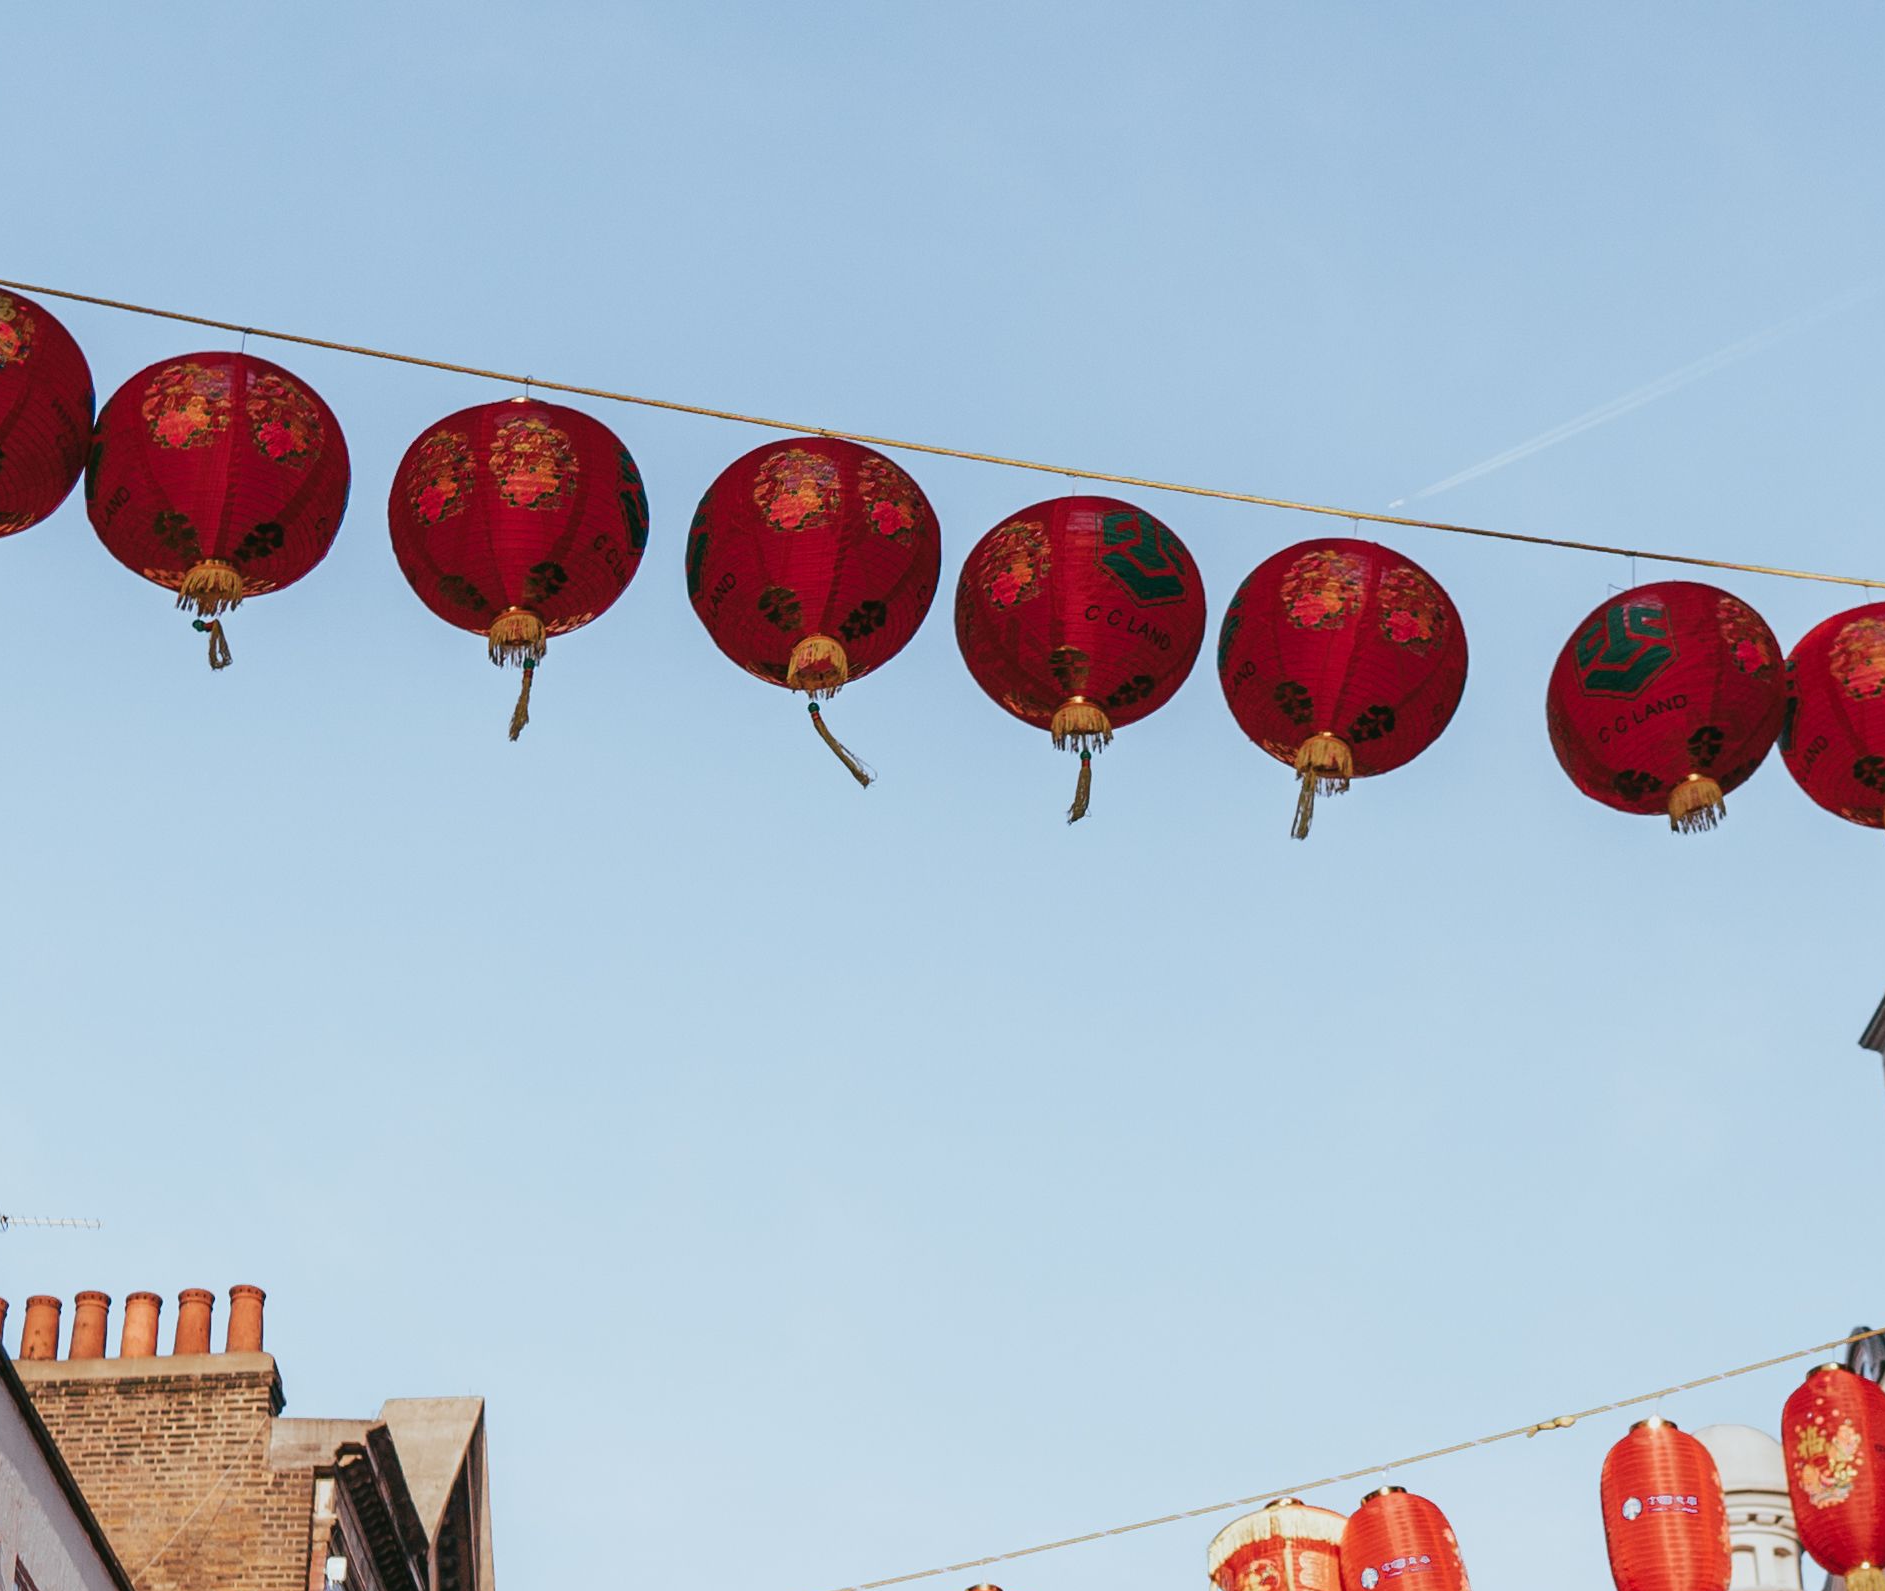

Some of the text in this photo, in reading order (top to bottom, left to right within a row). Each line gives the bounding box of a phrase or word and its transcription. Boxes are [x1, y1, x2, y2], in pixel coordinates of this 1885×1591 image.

[1085, 605, 1172, 652] C C LAND
[1598, 693, 1689, 744] C C LAND
